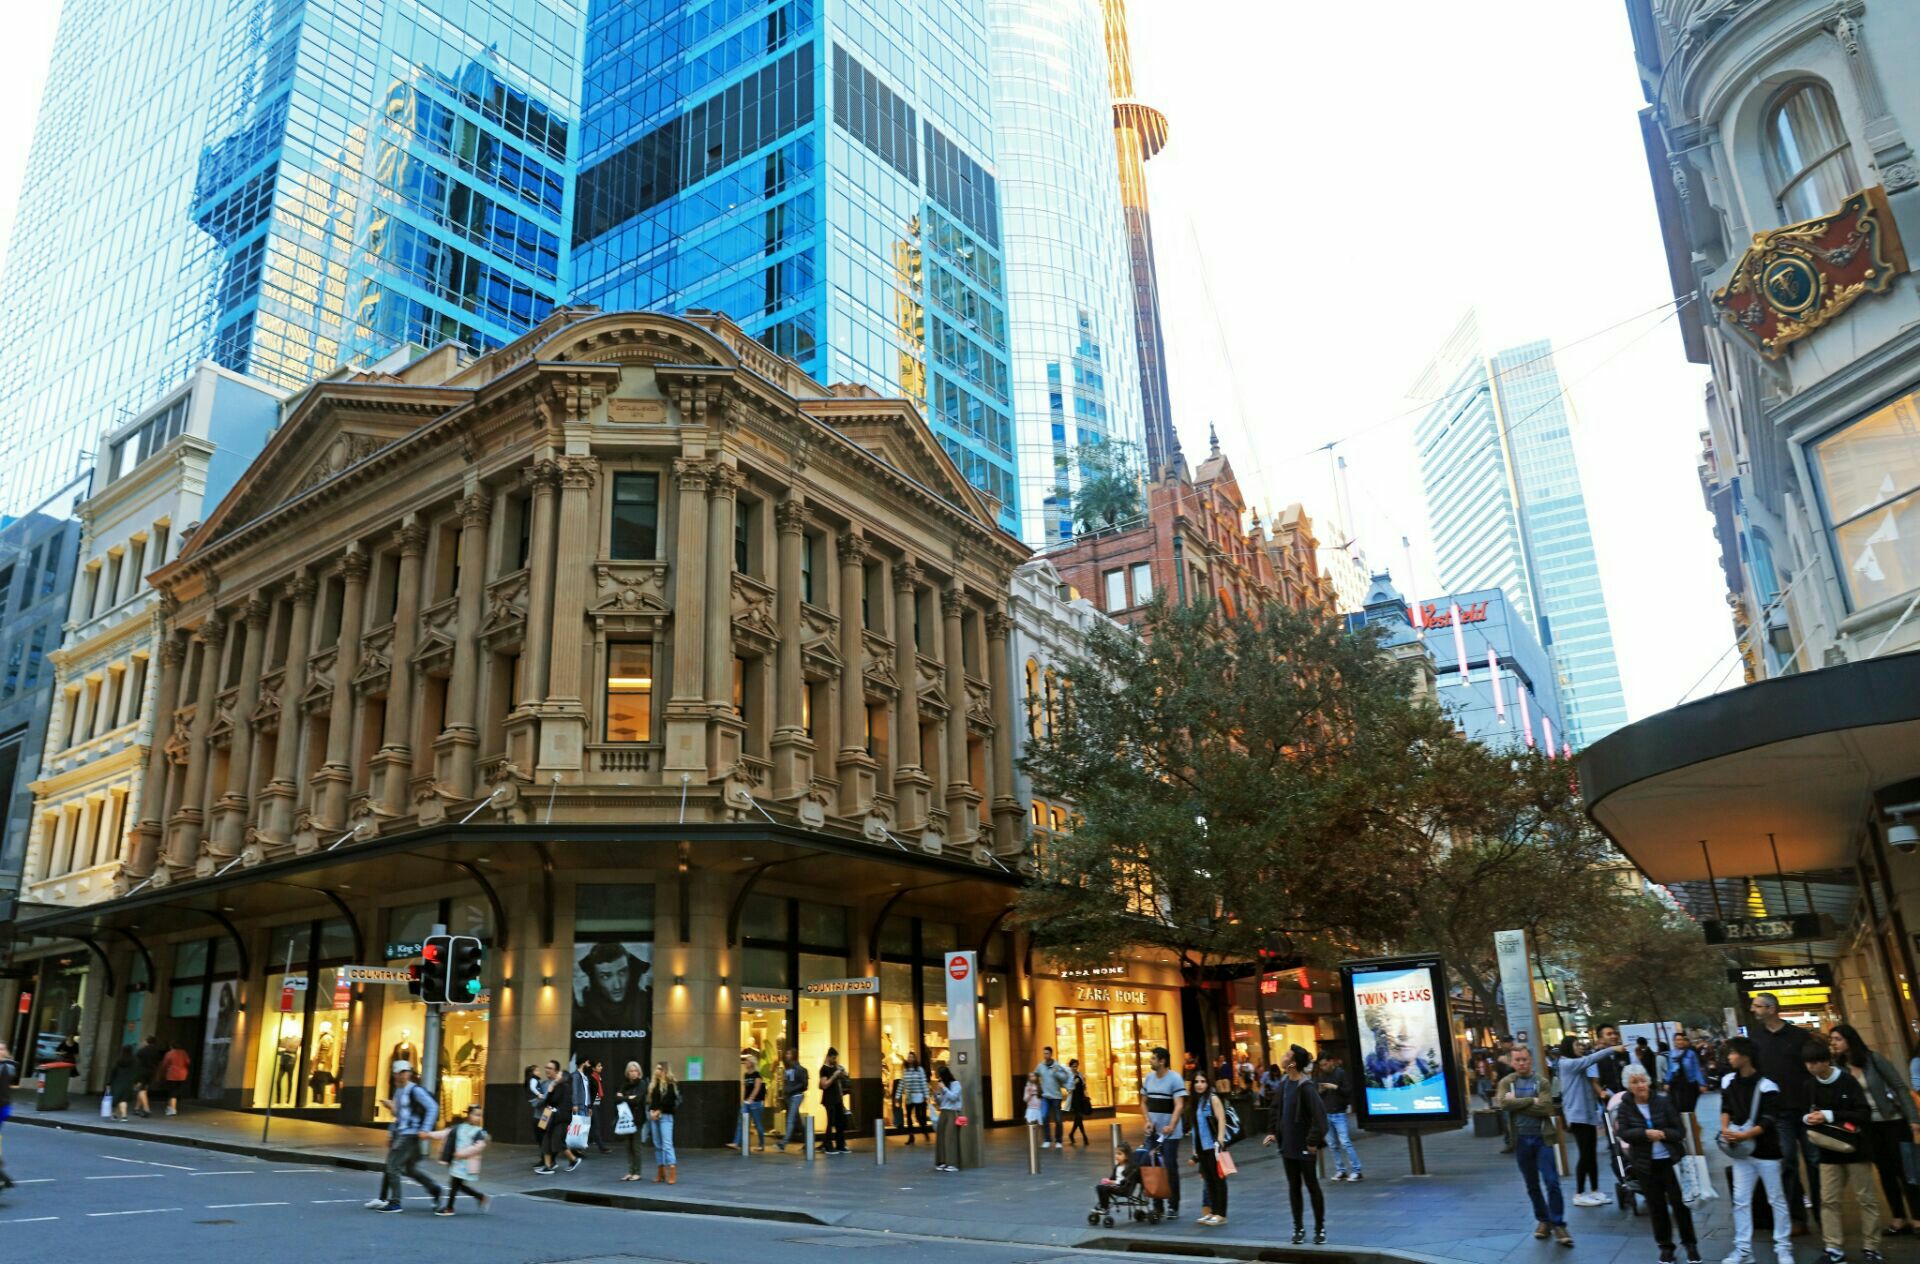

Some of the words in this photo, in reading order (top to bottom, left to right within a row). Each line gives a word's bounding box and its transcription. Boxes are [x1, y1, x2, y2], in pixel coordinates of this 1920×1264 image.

[1407, 601, 1488, 629] Westeld
[349, 969, 394, 980] COUNTRY
[1060, 970, 1090, 978] ZARA
[1092, 966, 1124, 975] HOME
[1755, 967, 1816, 978] BILLABONG
[807, 982, 847, 993] COUNTRY
[848, 981, 872, 990] ROAD
[1077, 986, 1110, 1001] ZARA
[1115, 989, 1147, 1005] HOME
[1357, 992, 1388, 1005] TWIN
[1392, 988, 1431, 1003] PEAKS
[575, 1030, 619, 1039] COUNTRY
[620, 1030, 646, 1038] ROAD
